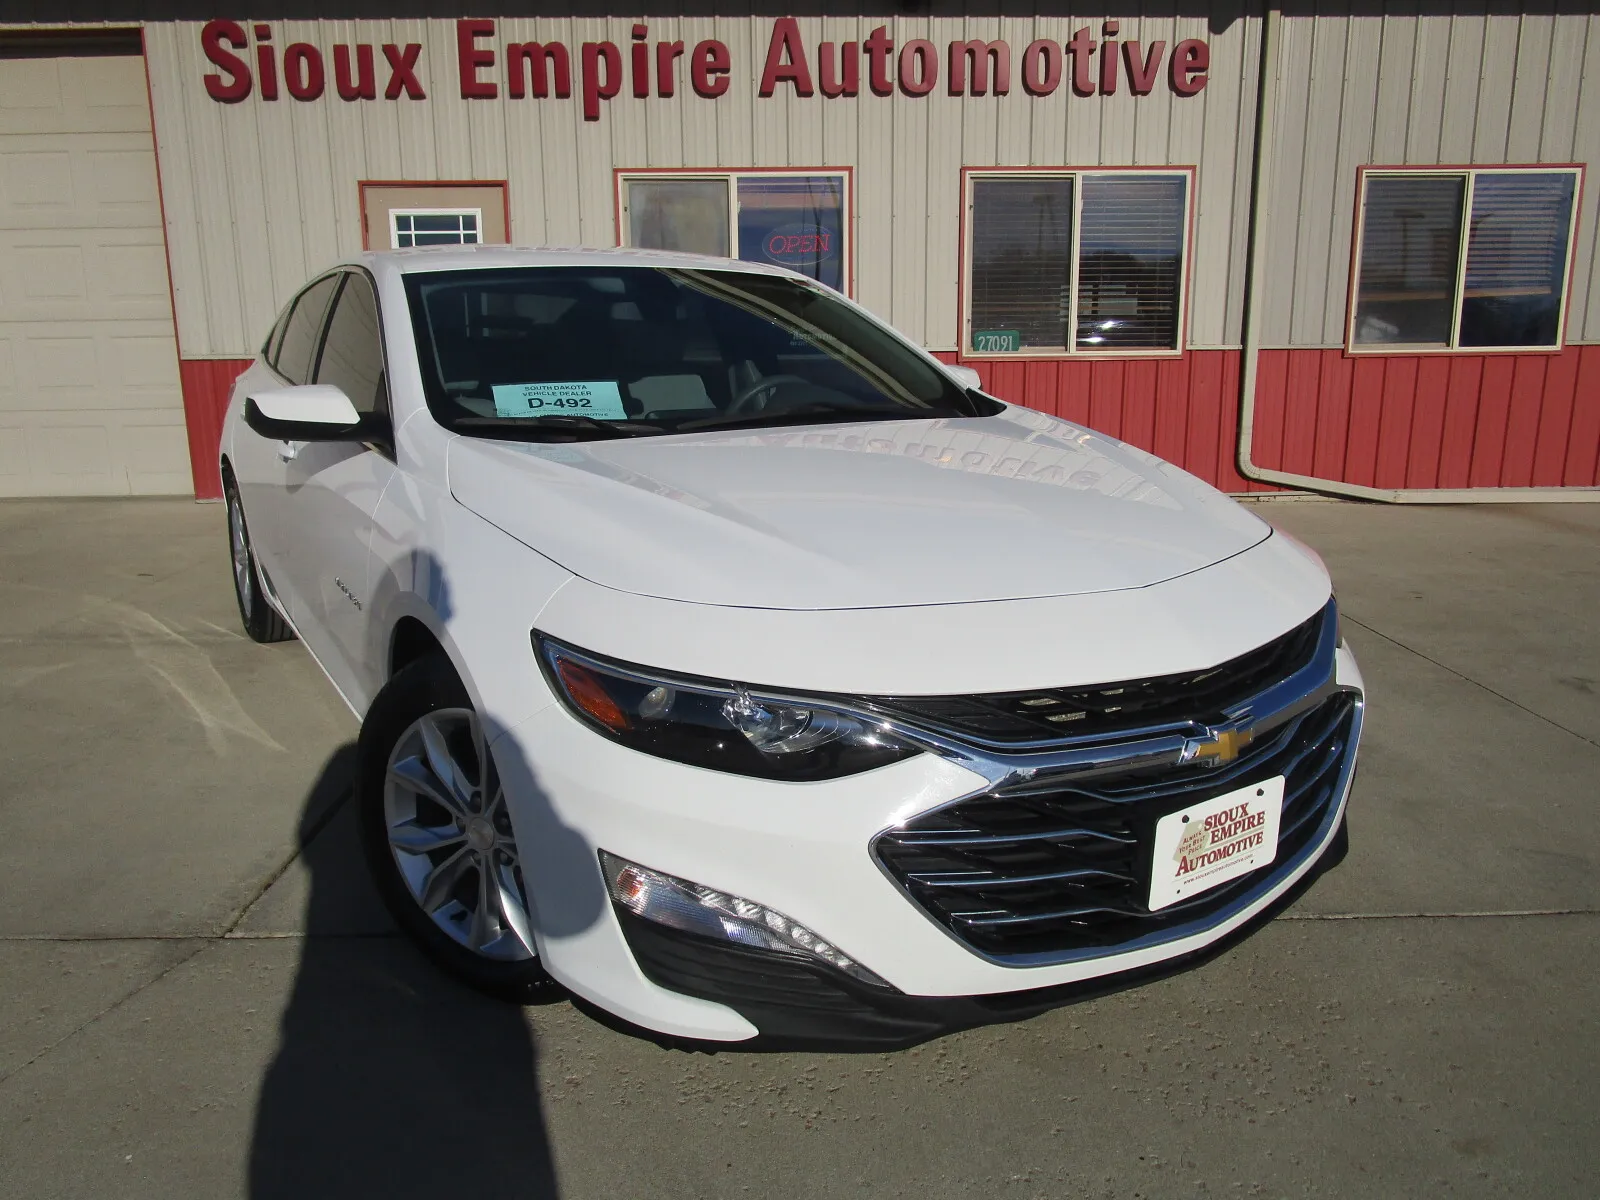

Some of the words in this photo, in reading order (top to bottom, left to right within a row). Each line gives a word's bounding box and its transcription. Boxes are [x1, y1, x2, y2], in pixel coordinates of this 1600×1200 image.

[201, 19, 426, 103] Sioux
[457, 19, 731, 122] Empire
[758, 17, 1210, 98] Automotive
[769, 233, 831, 254] OPEN
[978, 335, 1013, 351] 27091
[527, 398, 593, 409] D-492
[1204, 802, 1249, 831] SIOUX
[1210, 811, 1265, 845] EMPIRE
[1175, 831, 1264, 877] AUTOMOTIVE
